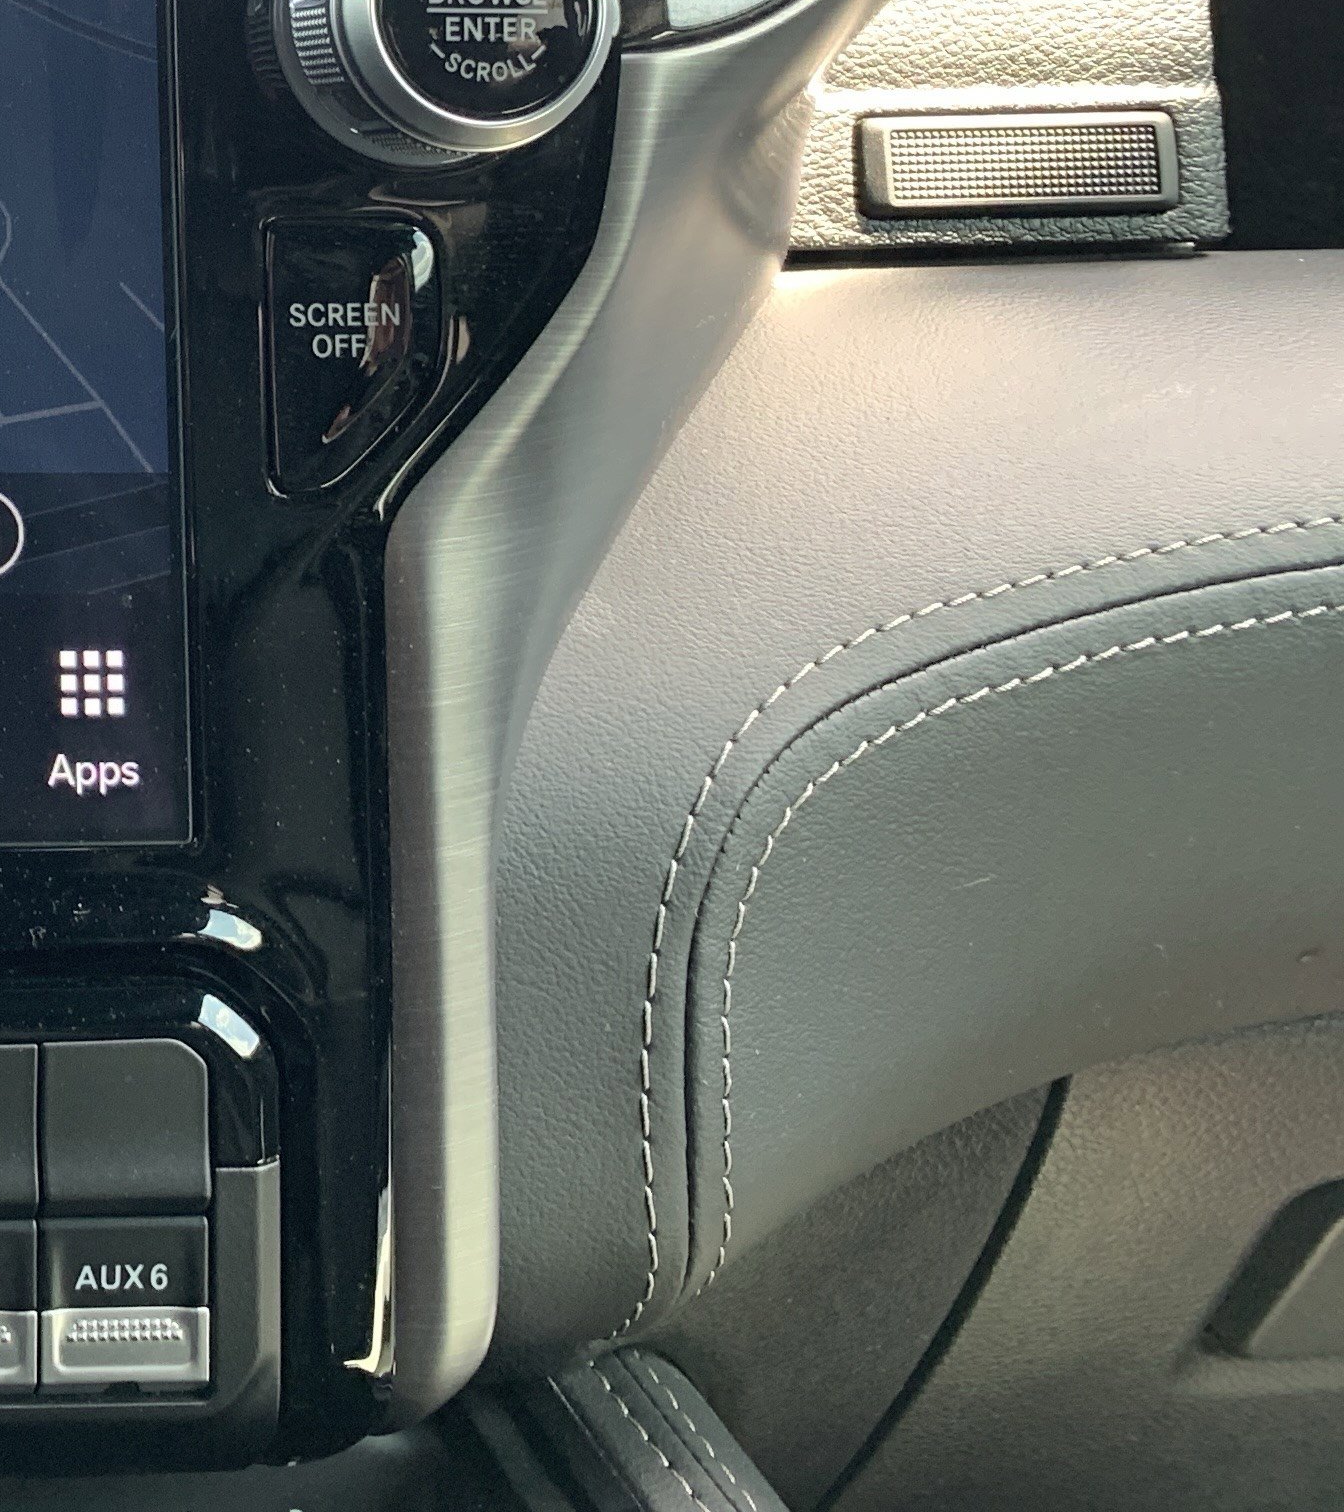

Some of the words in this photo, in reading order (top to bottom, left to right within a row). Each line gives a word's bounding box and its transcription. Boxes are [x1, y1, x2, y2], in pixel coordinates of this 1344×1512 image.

[445, 17, 537, 42] ENTER
[445, 53, 537, 82] SCROLL
[289, 303, 400, 327] SCREEN
[312, 333, 366, 358] OFF
[48, 754, 140, 794] Apps
[75, 1265, 144, 1290] AUX
[151, 1264, 168, 1290] 6
